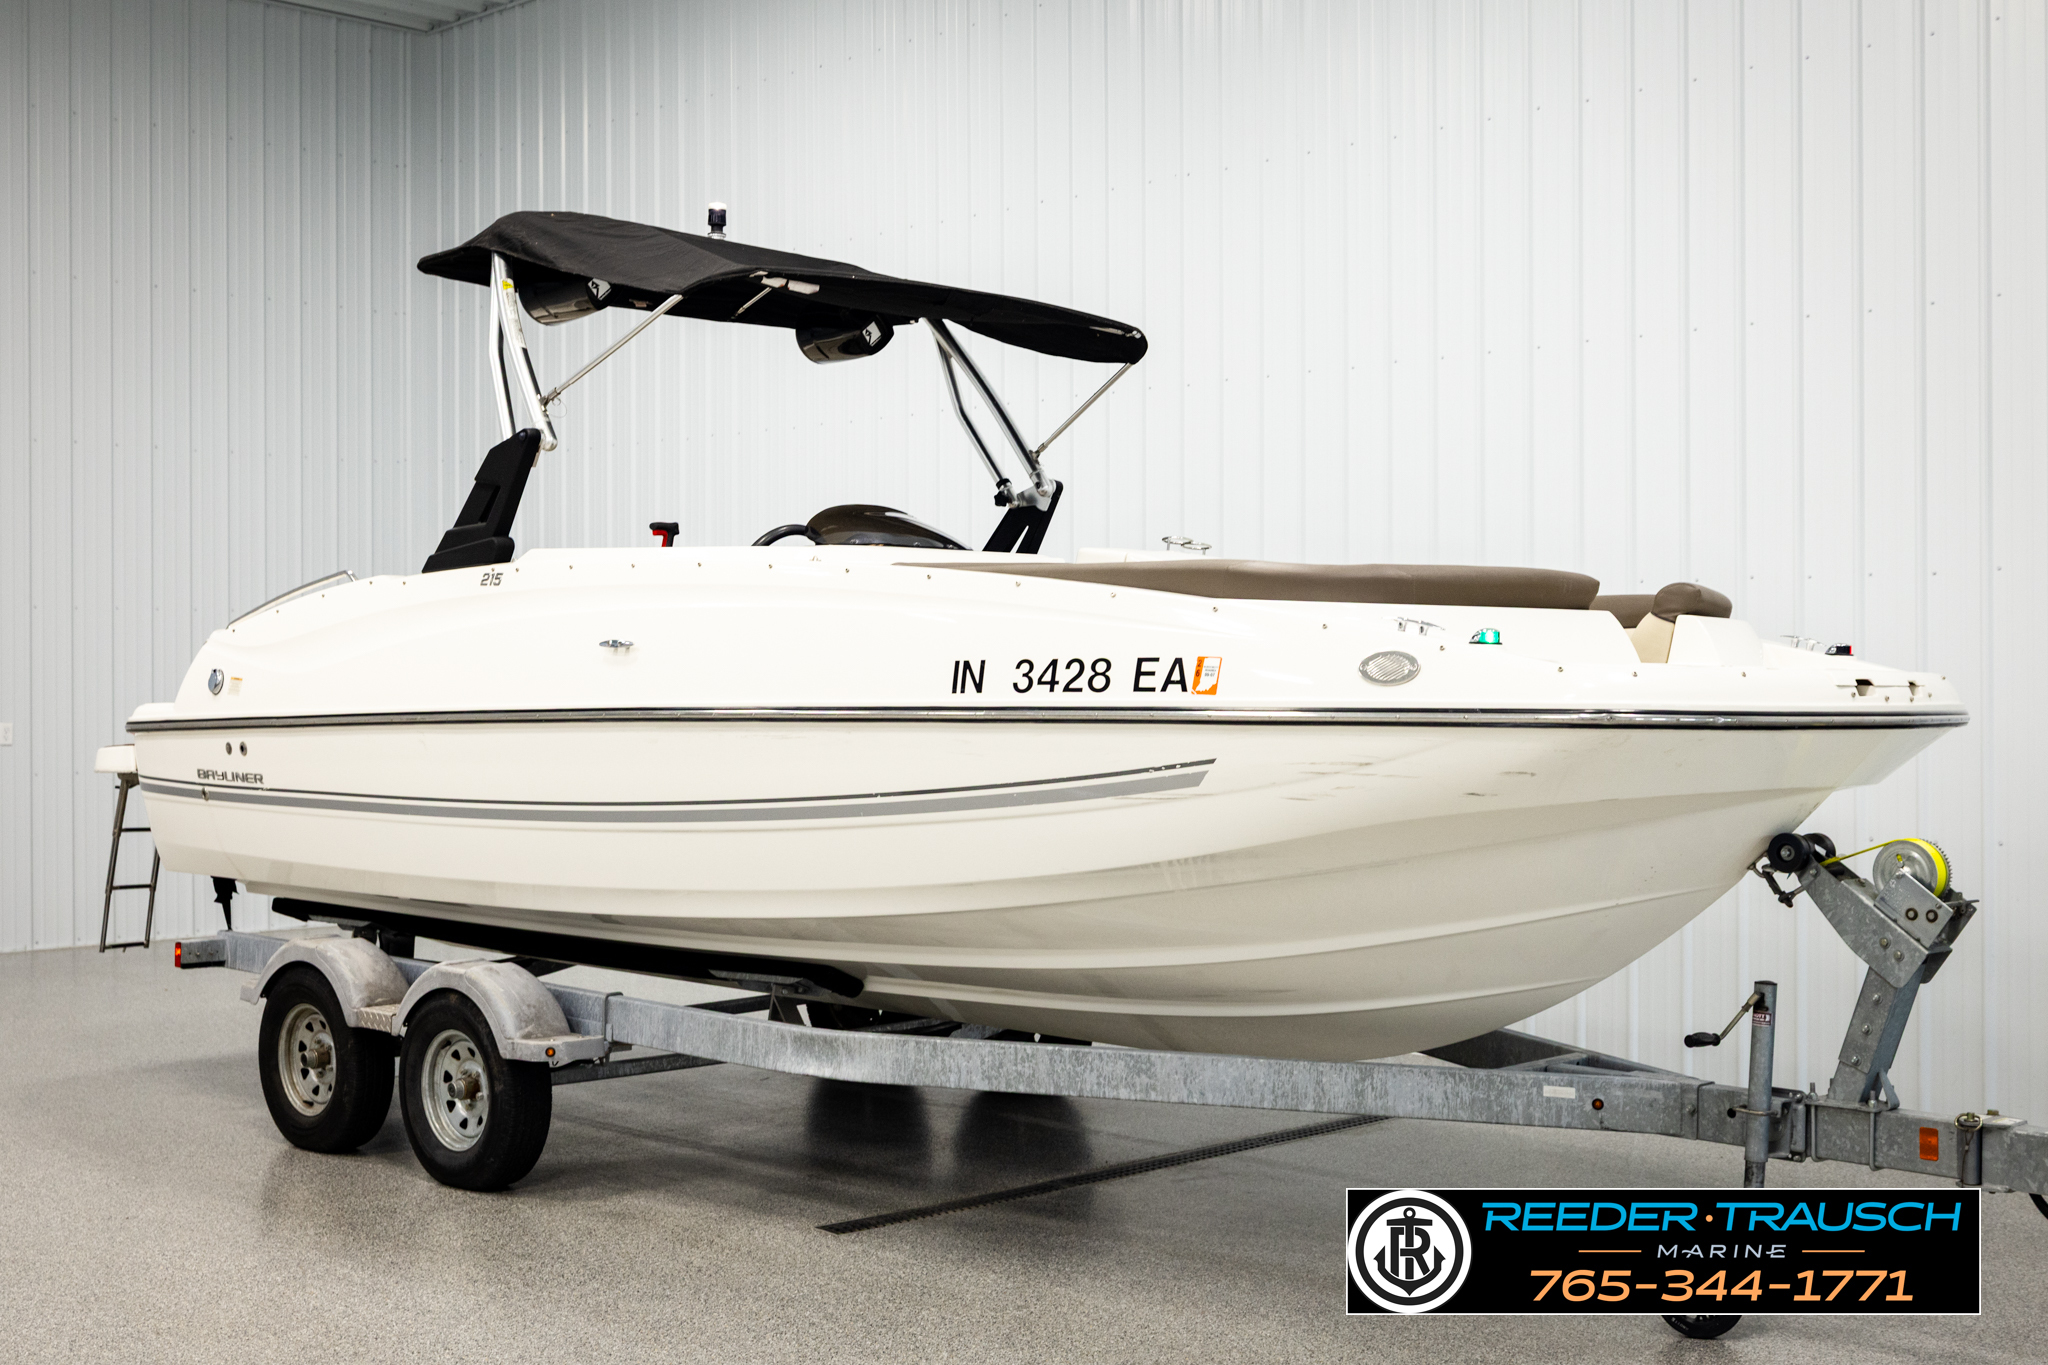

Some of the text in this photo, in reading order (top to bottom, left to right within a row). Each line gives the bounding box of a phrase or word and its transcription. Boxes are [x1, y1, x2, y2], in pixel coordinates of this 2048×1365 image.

[480, 572, 504, 586] 215
[951, 657, 1188, 694] IN 3428 EA
[197, 768, 264, 785] BAYLINER
